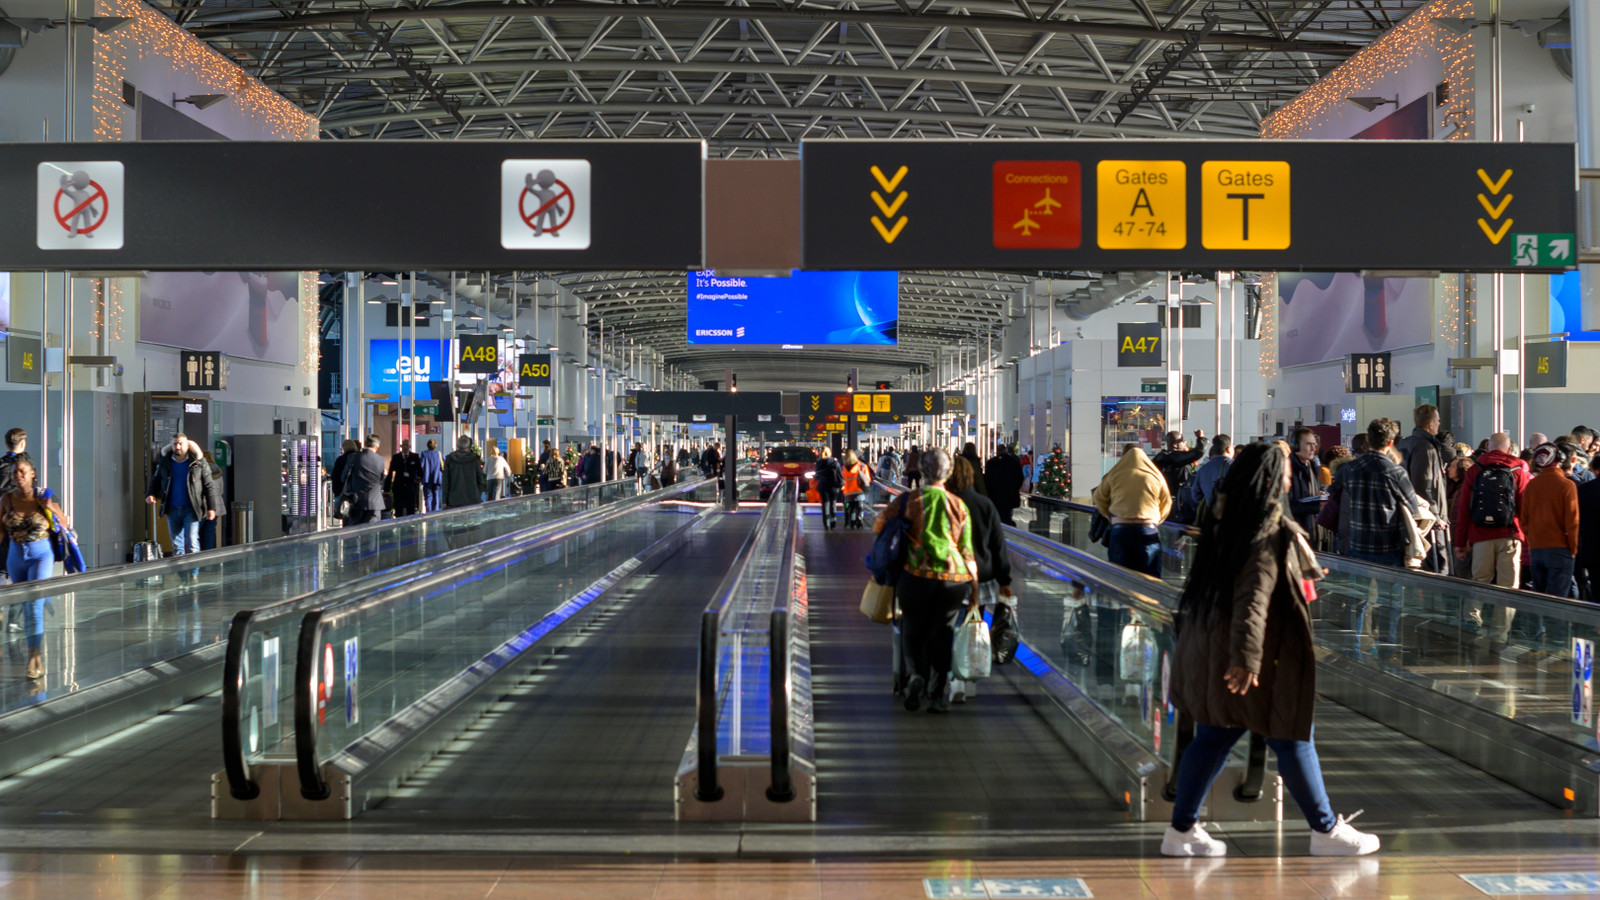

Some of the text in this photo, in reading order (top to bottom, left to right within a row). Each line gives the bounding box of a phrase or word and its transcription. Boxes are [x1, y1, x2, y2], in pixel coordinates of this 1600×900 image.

[1005, 173, 1068, 184] Connections
[1115, 169, 1168, 185] Gates
[1217, 169, 1274, 186] Gates
[1130, 188, 1154, 217] A
[1226, 193, 1265, 241] T
[696, 278, 747, 287] It's Possible.
[1120, 336, 1159, 353] A47
[461, 345, 497, 362] A48
[521, 363, 550, 377] A50
